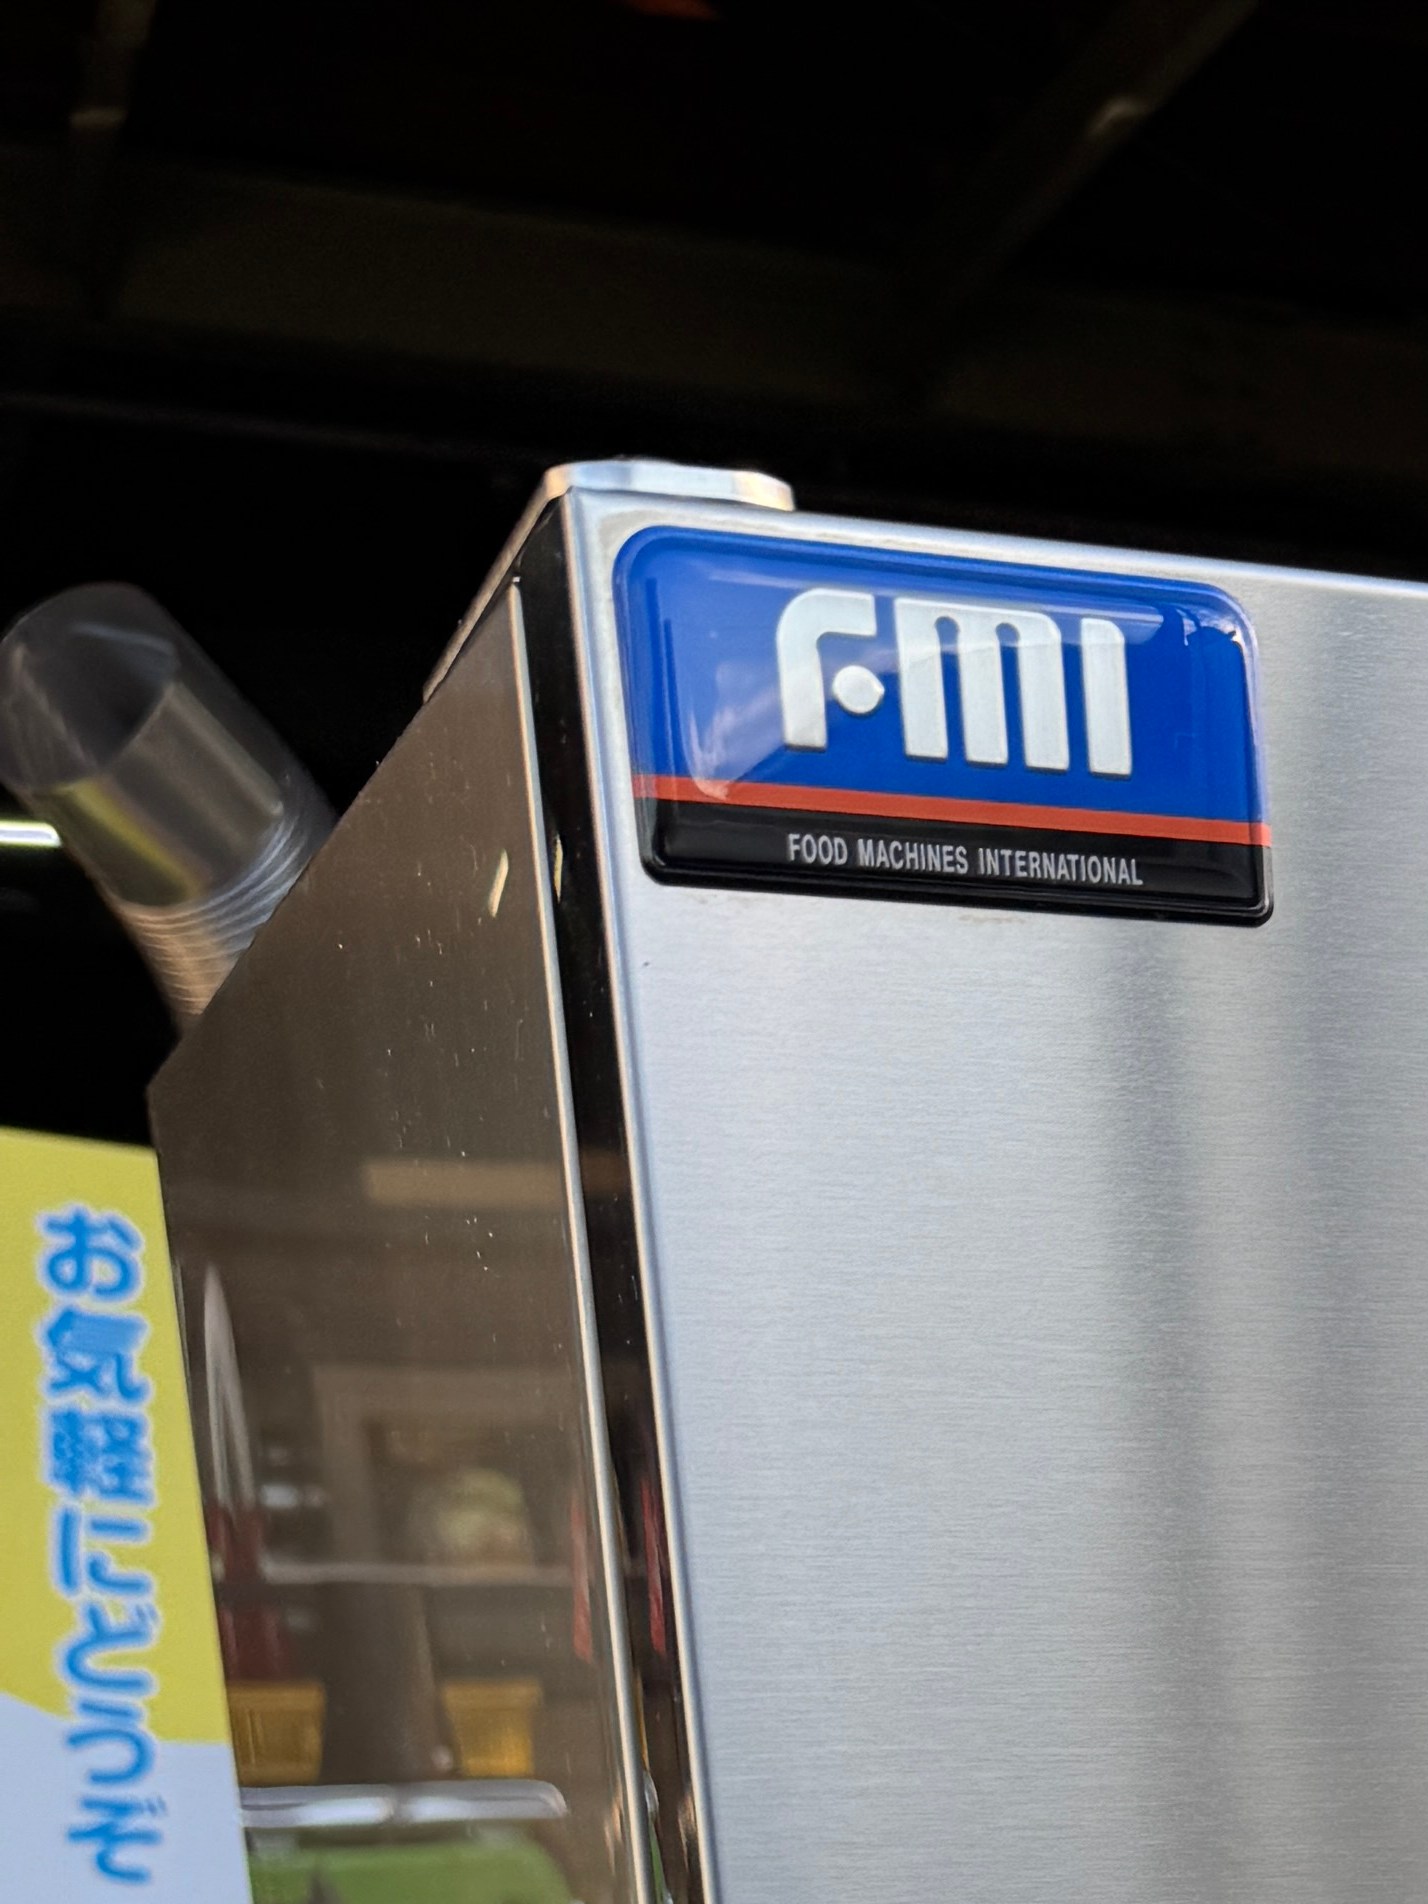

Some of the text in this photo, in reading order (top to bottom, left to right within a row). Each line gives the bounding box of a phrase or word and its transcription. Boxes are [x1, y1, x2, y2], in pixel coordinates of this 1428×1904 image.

[789, 834, 1143, 886] FOOD MACHINES INTERNATIONAL
